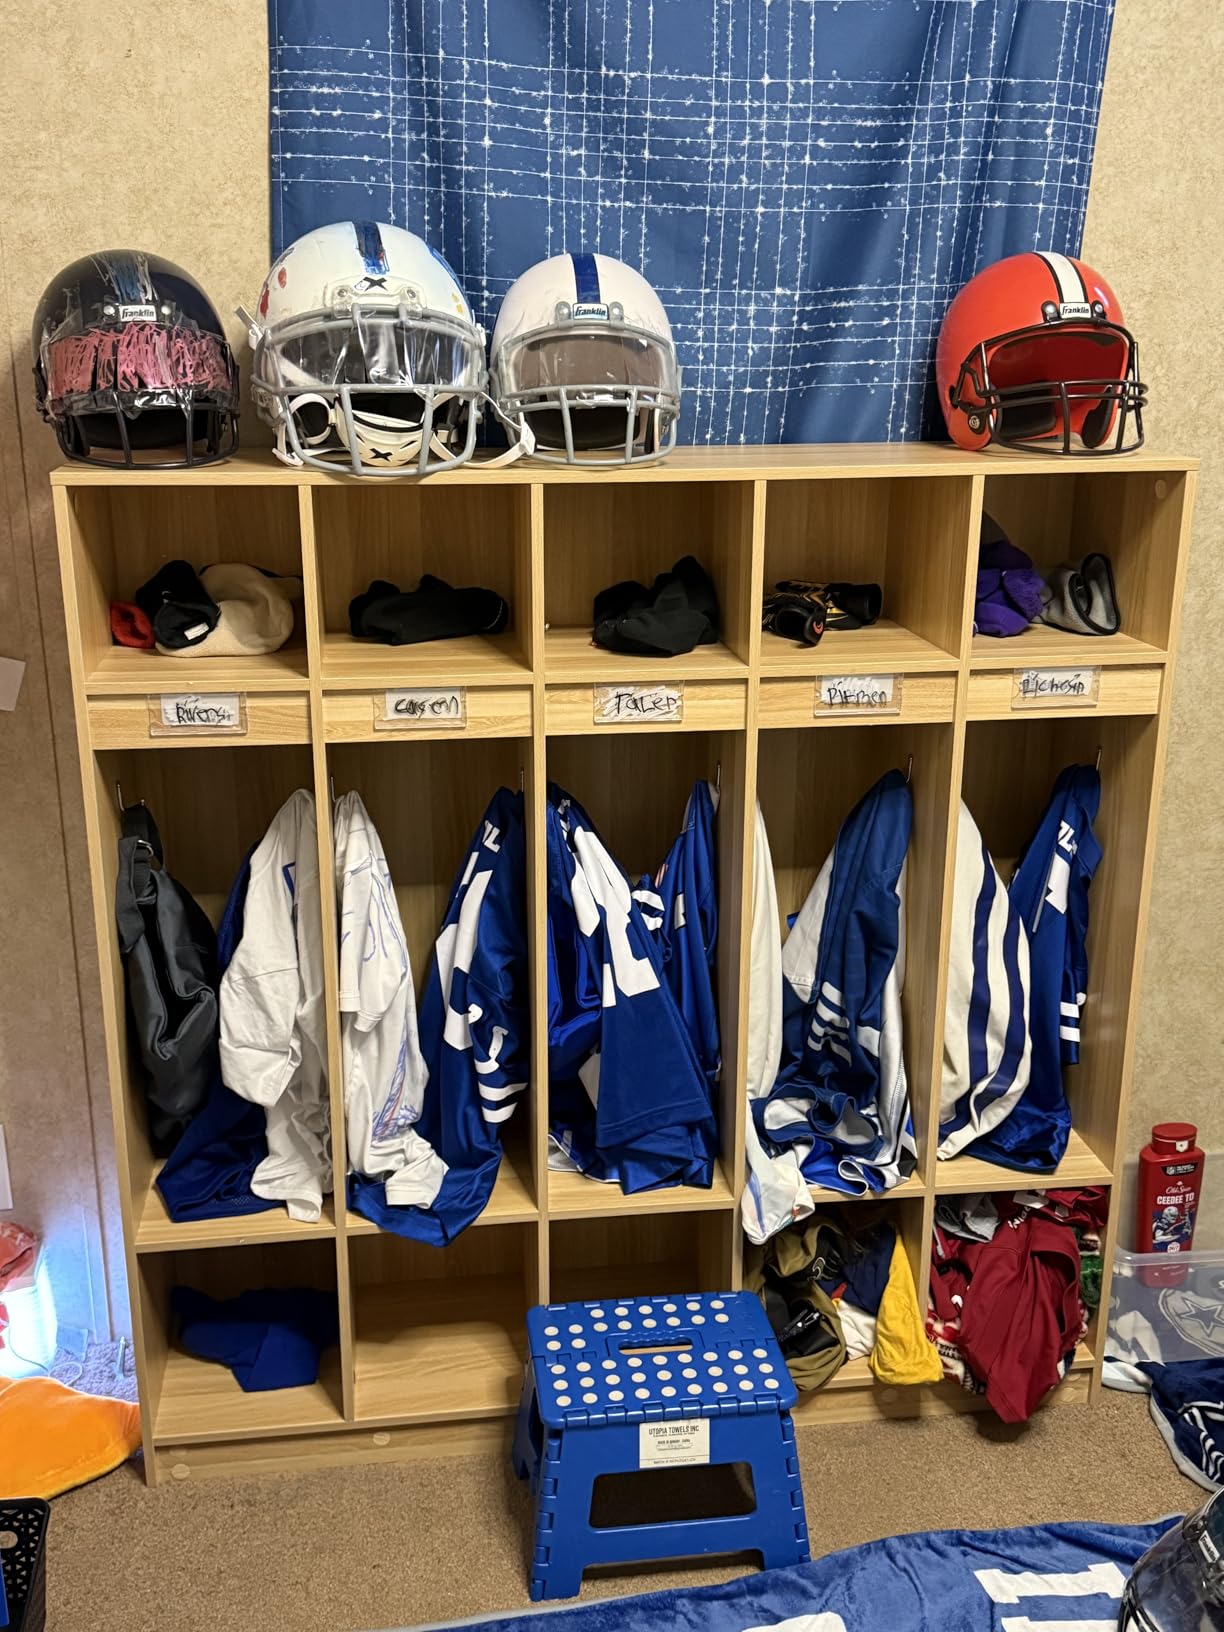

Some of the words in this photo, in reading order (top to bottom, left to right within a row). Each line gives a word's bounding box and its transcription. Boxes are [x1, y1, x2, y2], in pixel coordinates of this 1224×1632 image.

[121, 308, 155, 320] Franklin
[575, 305, 607, 317] Franklin
[1061, 305, 1090, 316] Franklin
[1156, 1195, 1184, 1206] CEEDEE
[648, 1427, 668, 1436] UTOPIA
[669, 1425, 690, 1434] TOWELS
